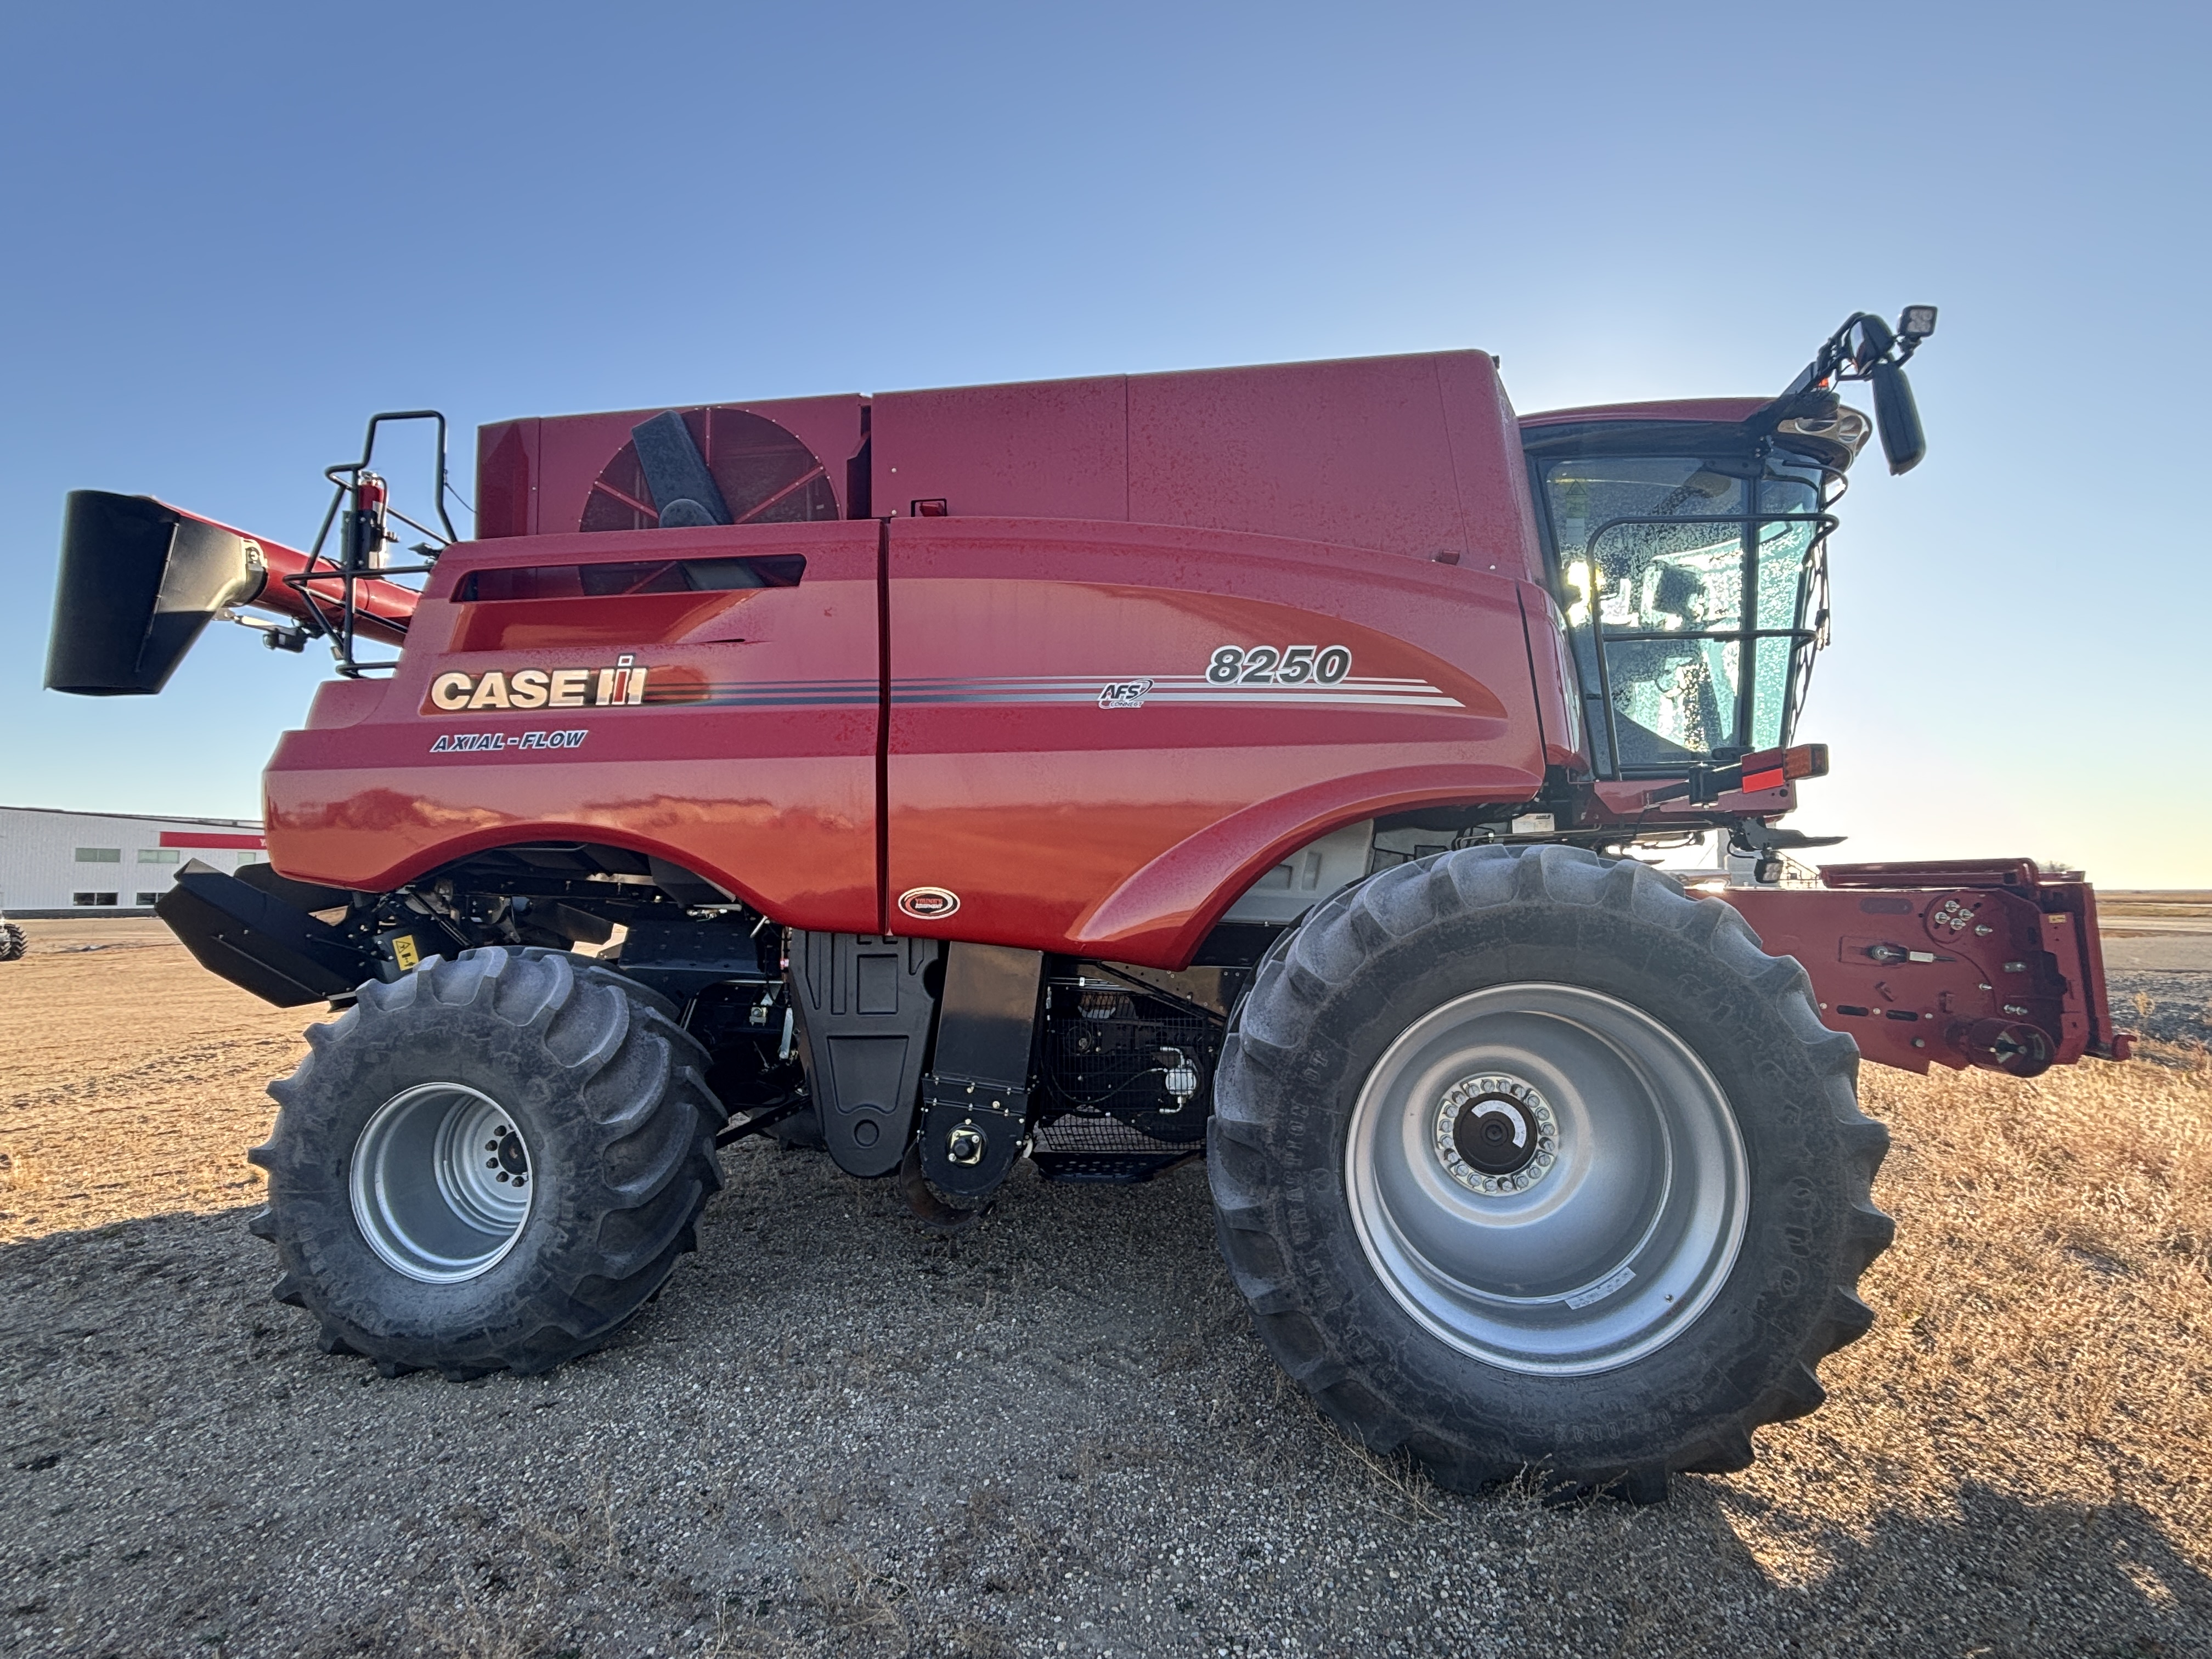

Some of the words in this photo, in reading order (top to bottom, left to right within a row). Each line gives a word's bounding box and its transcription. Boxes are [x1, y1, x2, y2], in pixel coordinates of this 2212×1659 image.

[1205, 645, 1352, 686] 8250
[431, 670, 590, 709] CASE
[1098, 683, 1142, 699] AFS
[431, 730, 588, 753] AXIAL-FLOW
